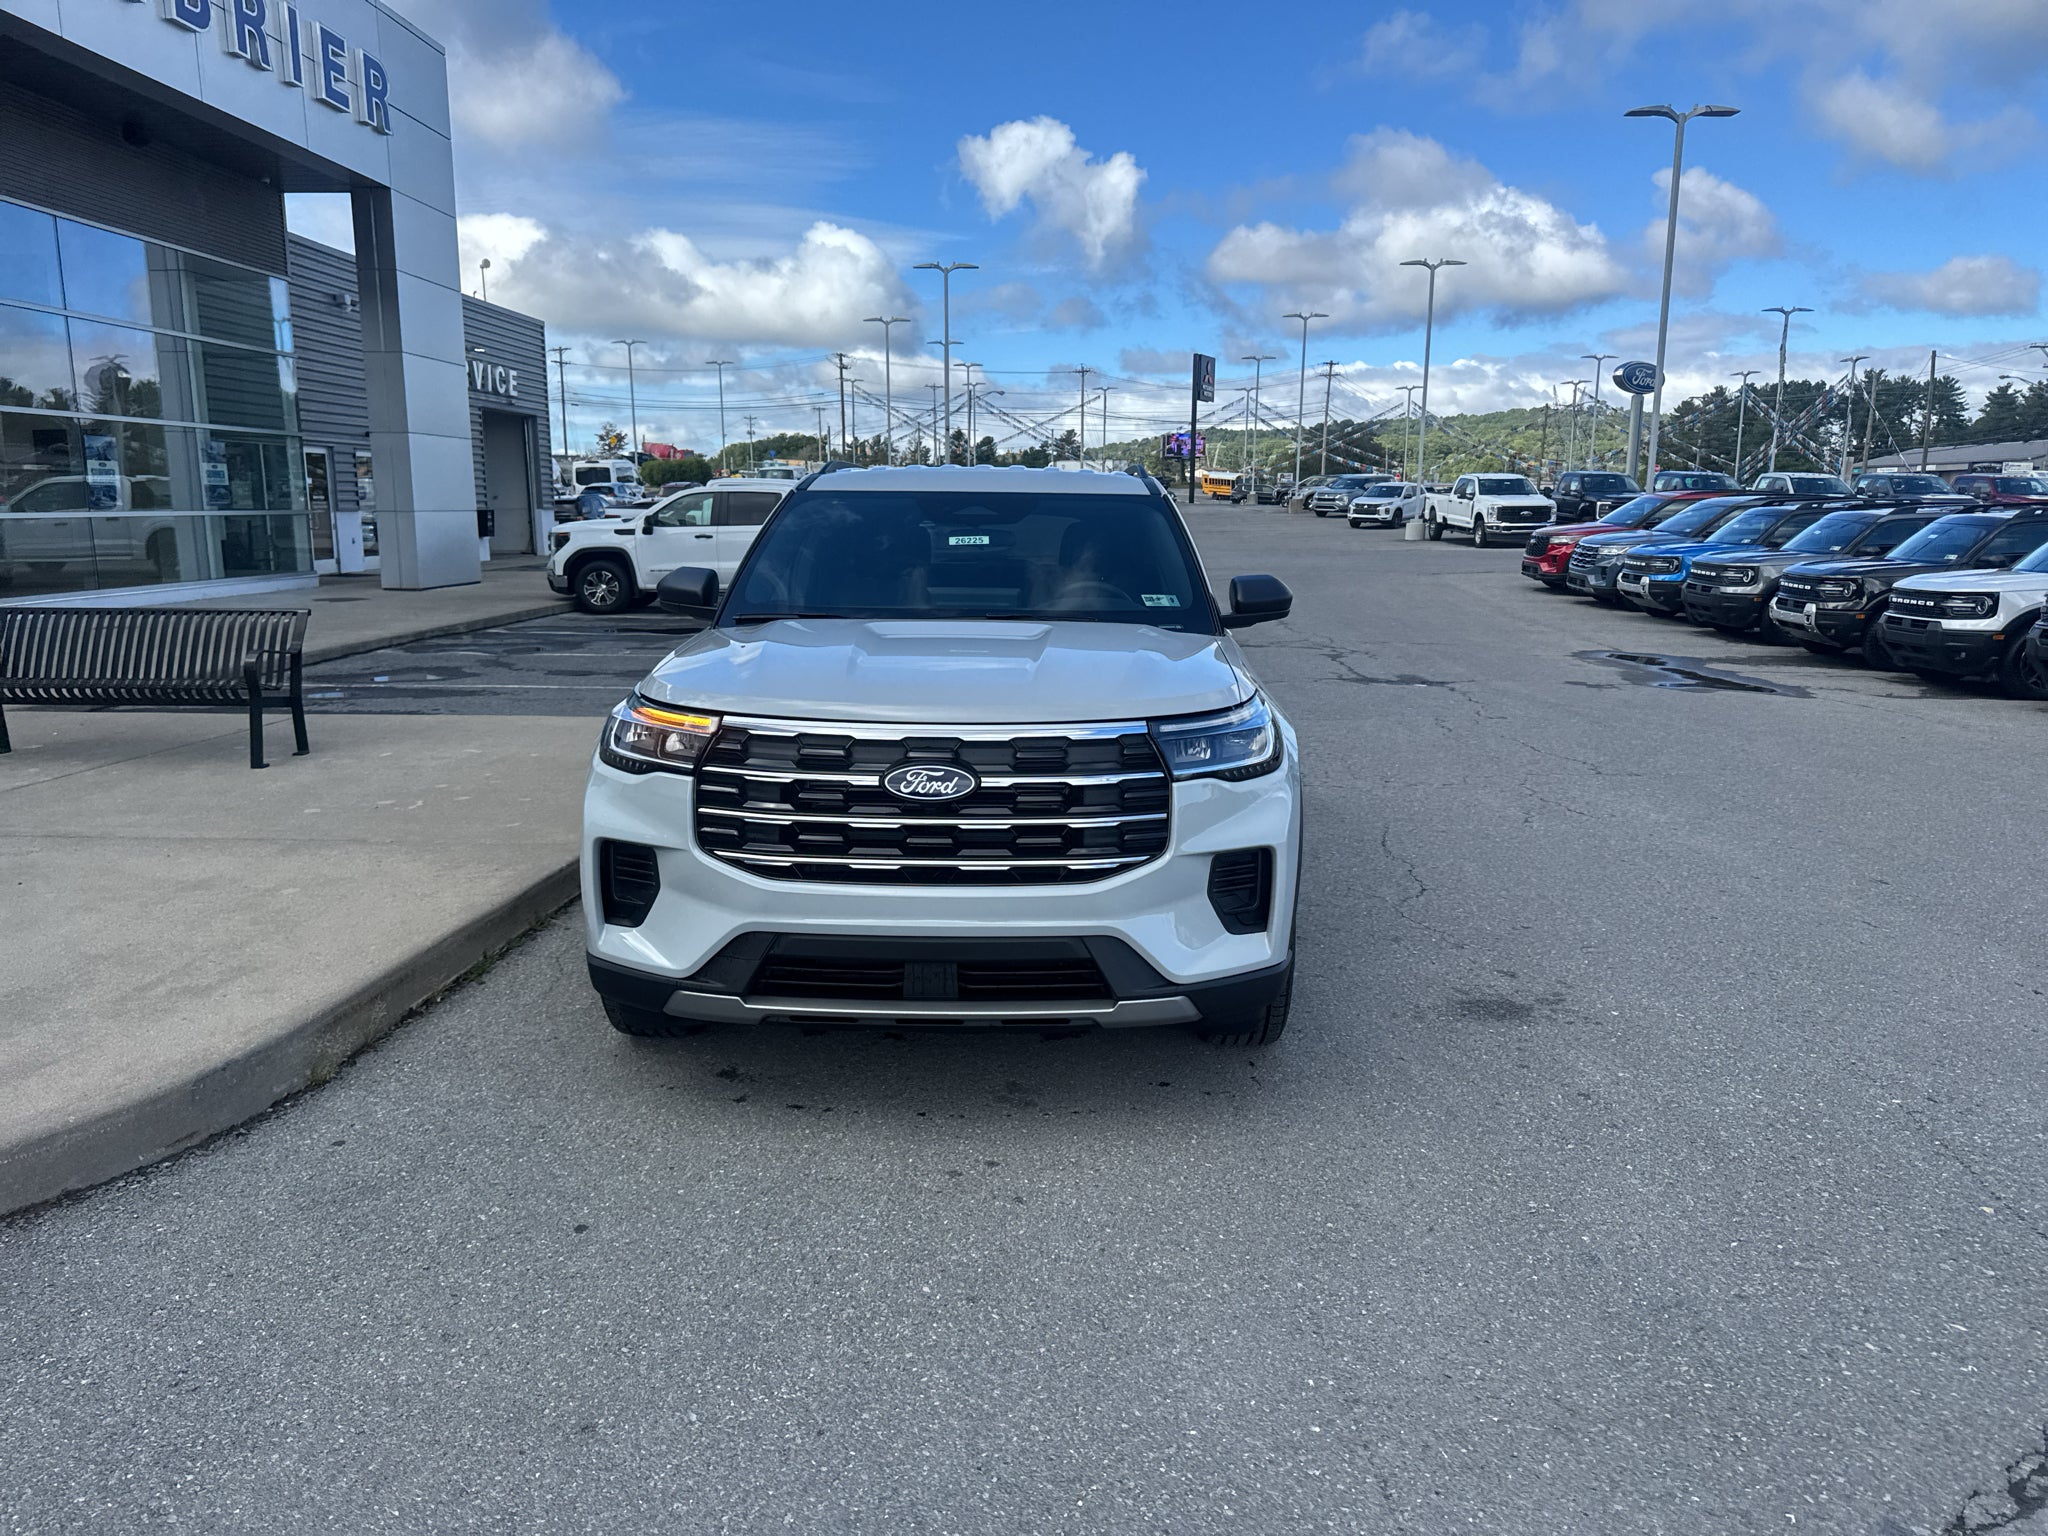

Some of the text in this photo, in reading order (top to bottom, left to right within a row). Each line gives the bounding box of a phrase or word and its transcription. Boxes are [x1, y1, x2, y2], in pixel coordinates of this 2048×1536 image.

[163, 0, 392, 135] RIER
[465, 360, 518, 397] VICE
[1891, 597, 1935, 607] BRONCO
[900, 769, 959, 794] Ford
